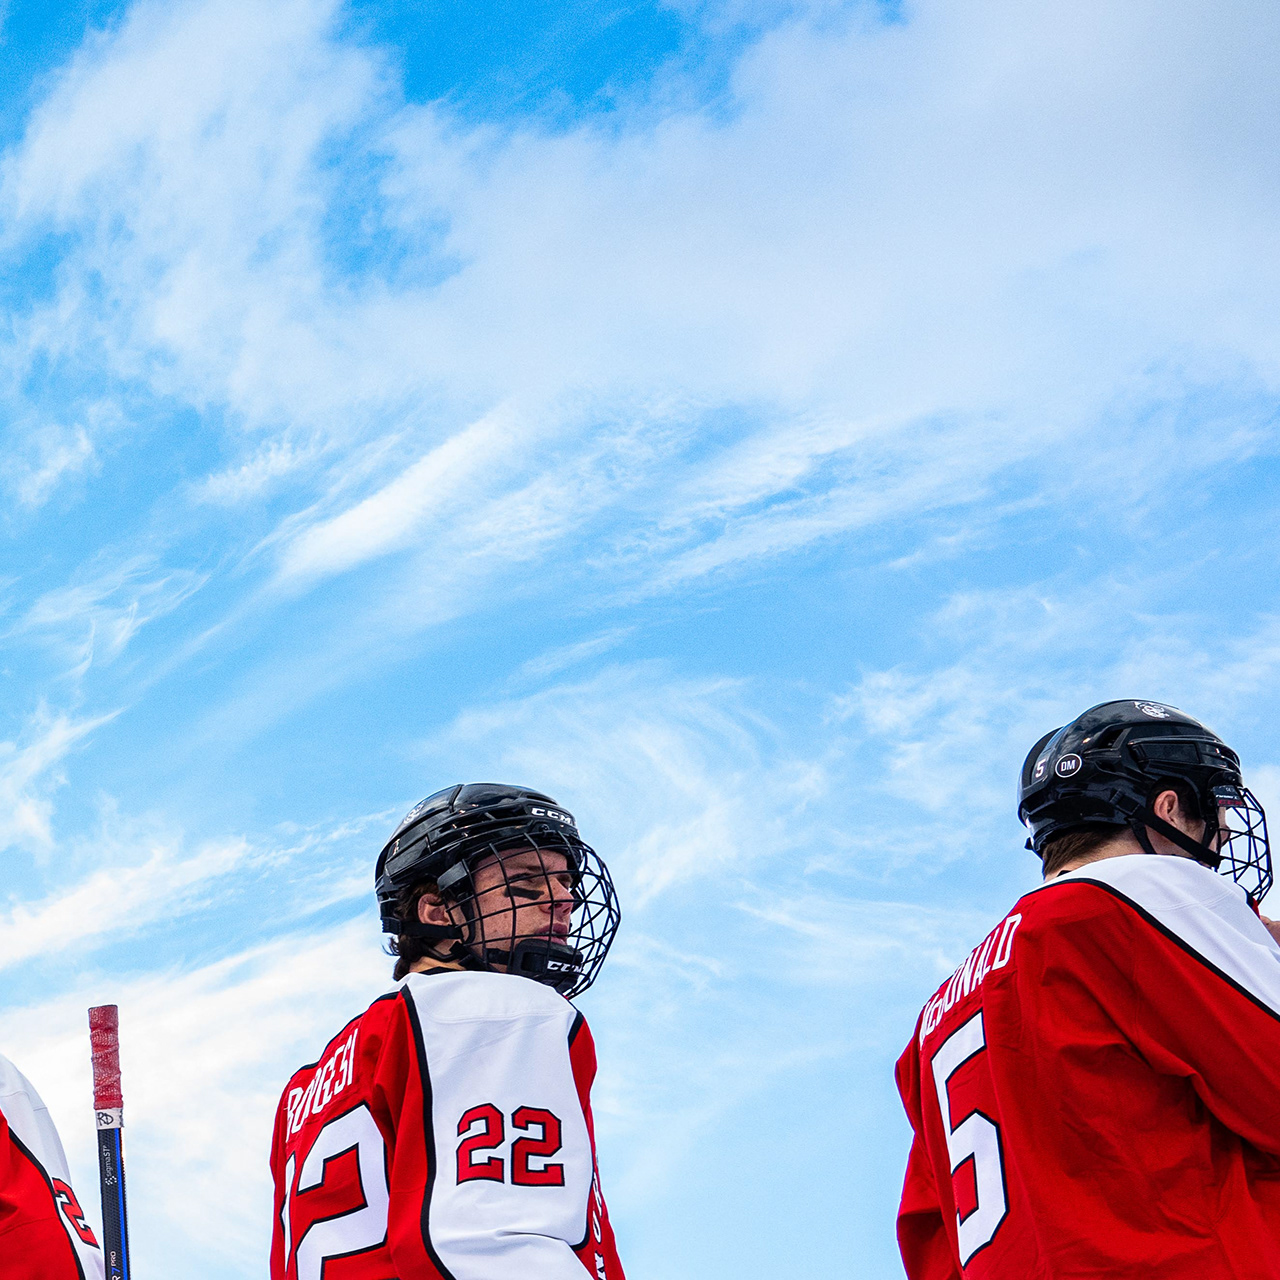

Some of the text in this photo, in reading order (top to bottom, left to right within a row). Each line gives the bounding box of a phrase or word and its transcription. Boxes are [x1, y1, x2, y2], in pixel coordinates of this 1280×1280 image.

[1035, 758, 1047, 778] 5
[1060, 758, 1077, 772] DM
[531, 806, 572, 825] CCM
[456, 1102, 566, 1187] 22
[109, 1250, 118, 1267] PRO
